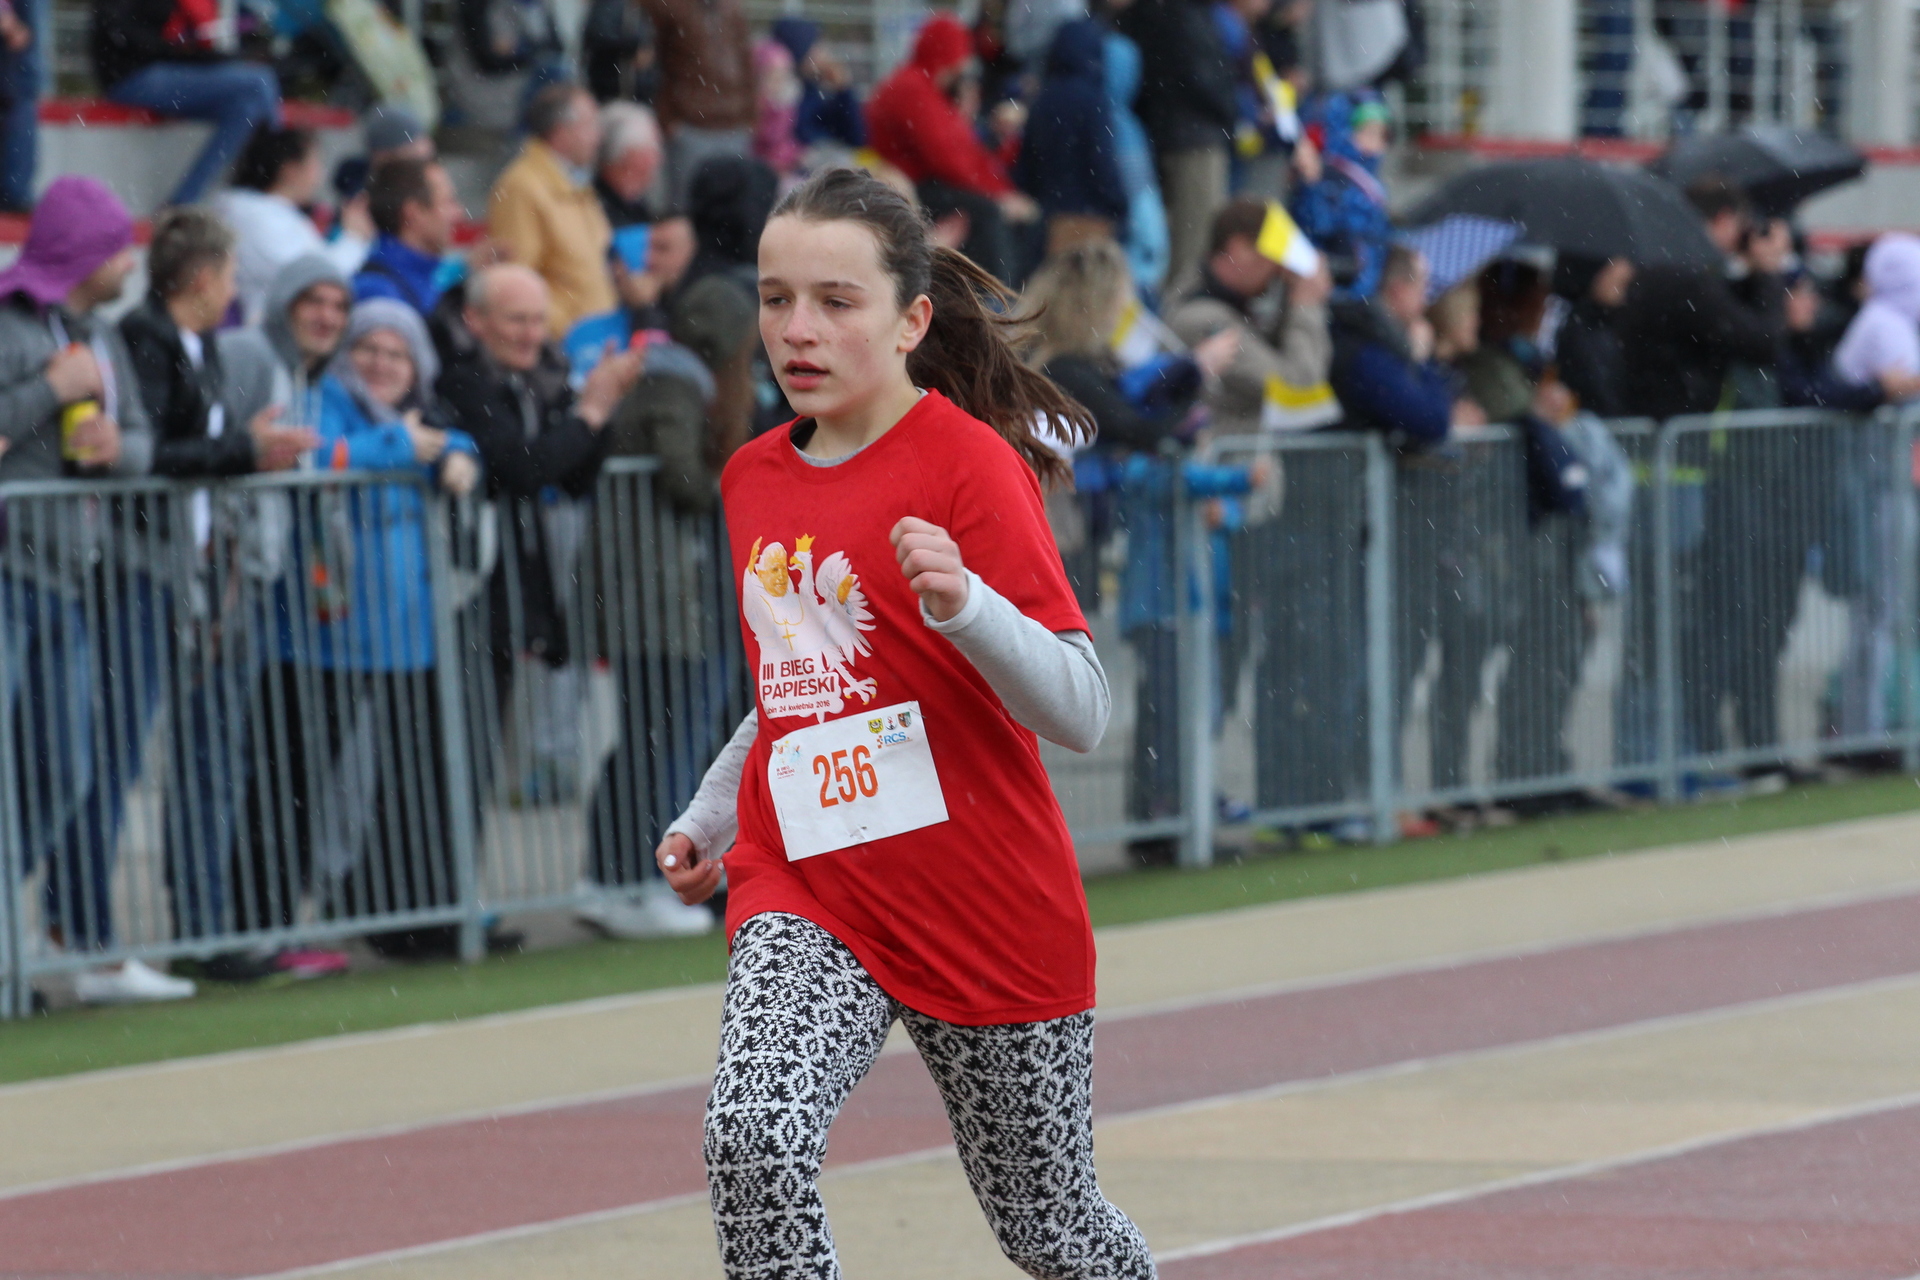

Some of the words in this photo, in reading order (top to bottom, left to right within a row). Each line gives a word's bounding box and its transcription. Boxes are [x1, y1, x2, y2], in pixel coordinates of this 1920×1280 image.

[763, 663, 774, 680] III
[781, 658, 814, 677] BIEG
[763, 676, 834, 700] PAPIESKI
[788, 702, 814, 711] kwietnia
[816, 700, 830, 708] 2016
[884, 731, 906, 744] RCS
[812, 745, 879, 808] 256
